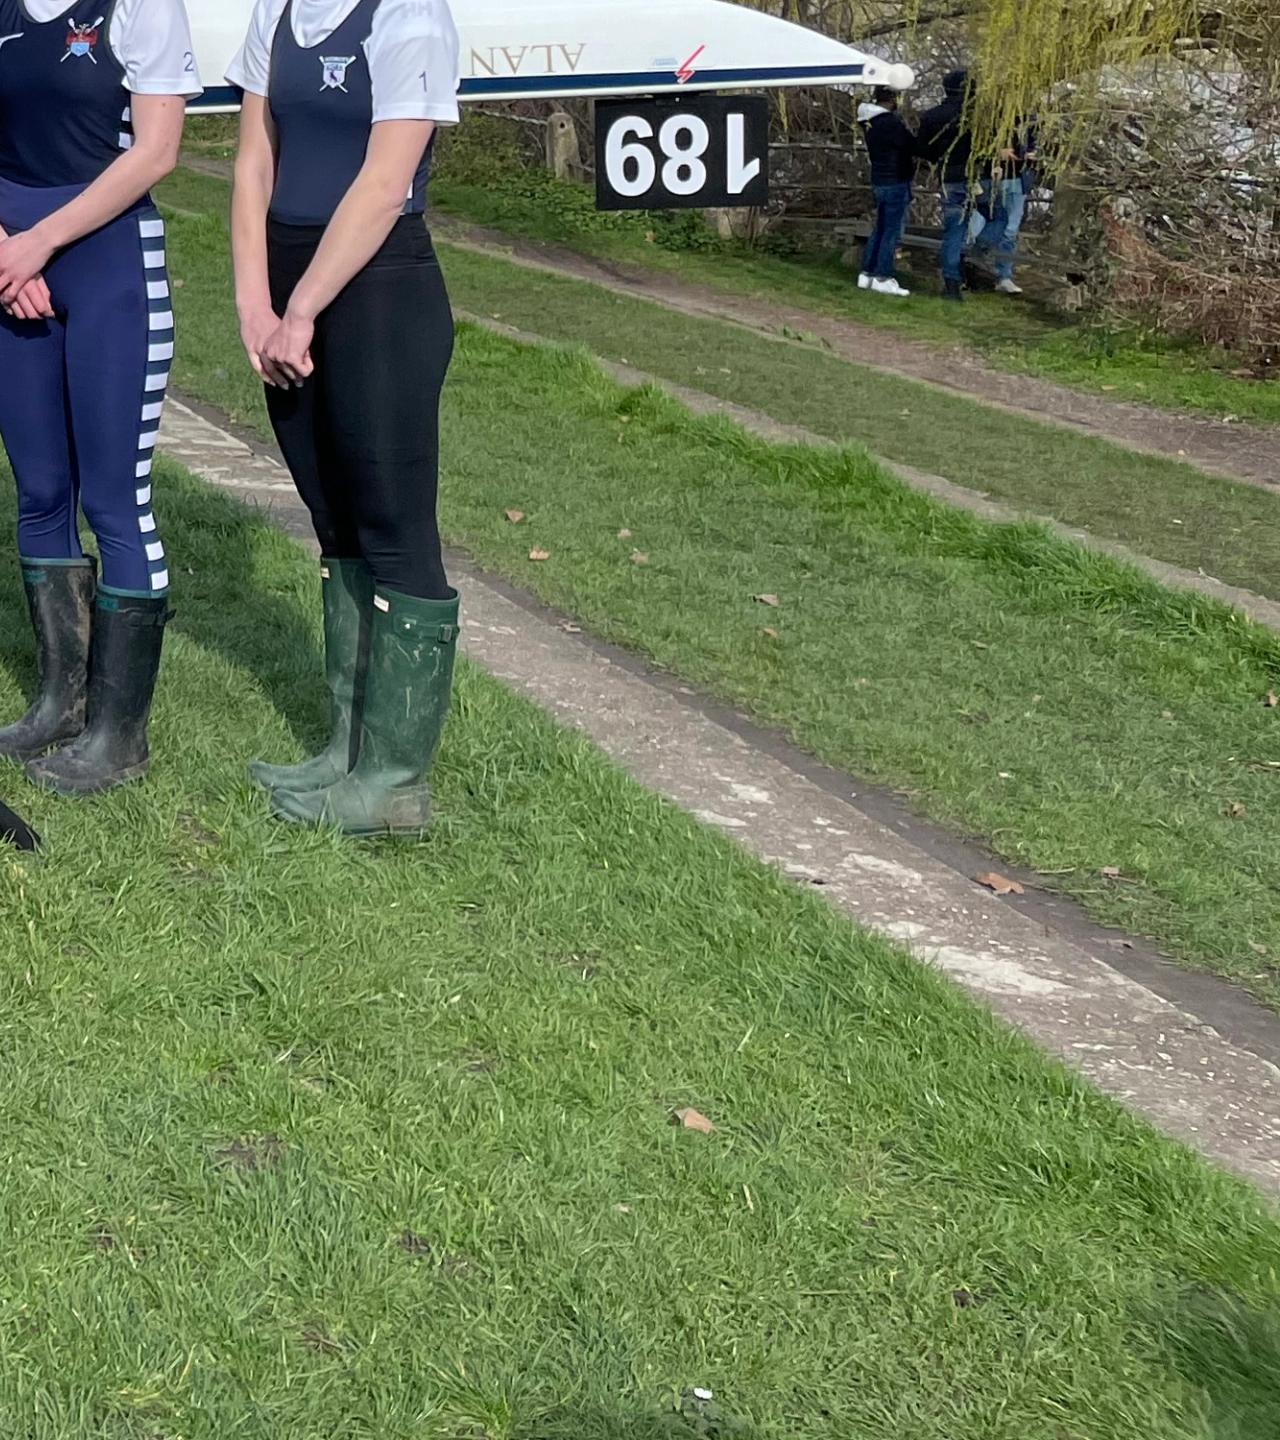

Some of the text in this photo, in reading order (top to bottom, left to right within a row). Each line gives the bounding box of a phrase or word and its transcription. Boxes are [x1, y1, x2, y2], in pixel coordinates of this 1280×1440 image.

[184, 51, 195, 72] 2
[471, 42, 587, 76] ALAN
[418, 71, 428, 92] 1
[605, 113, 760, 197] 189
